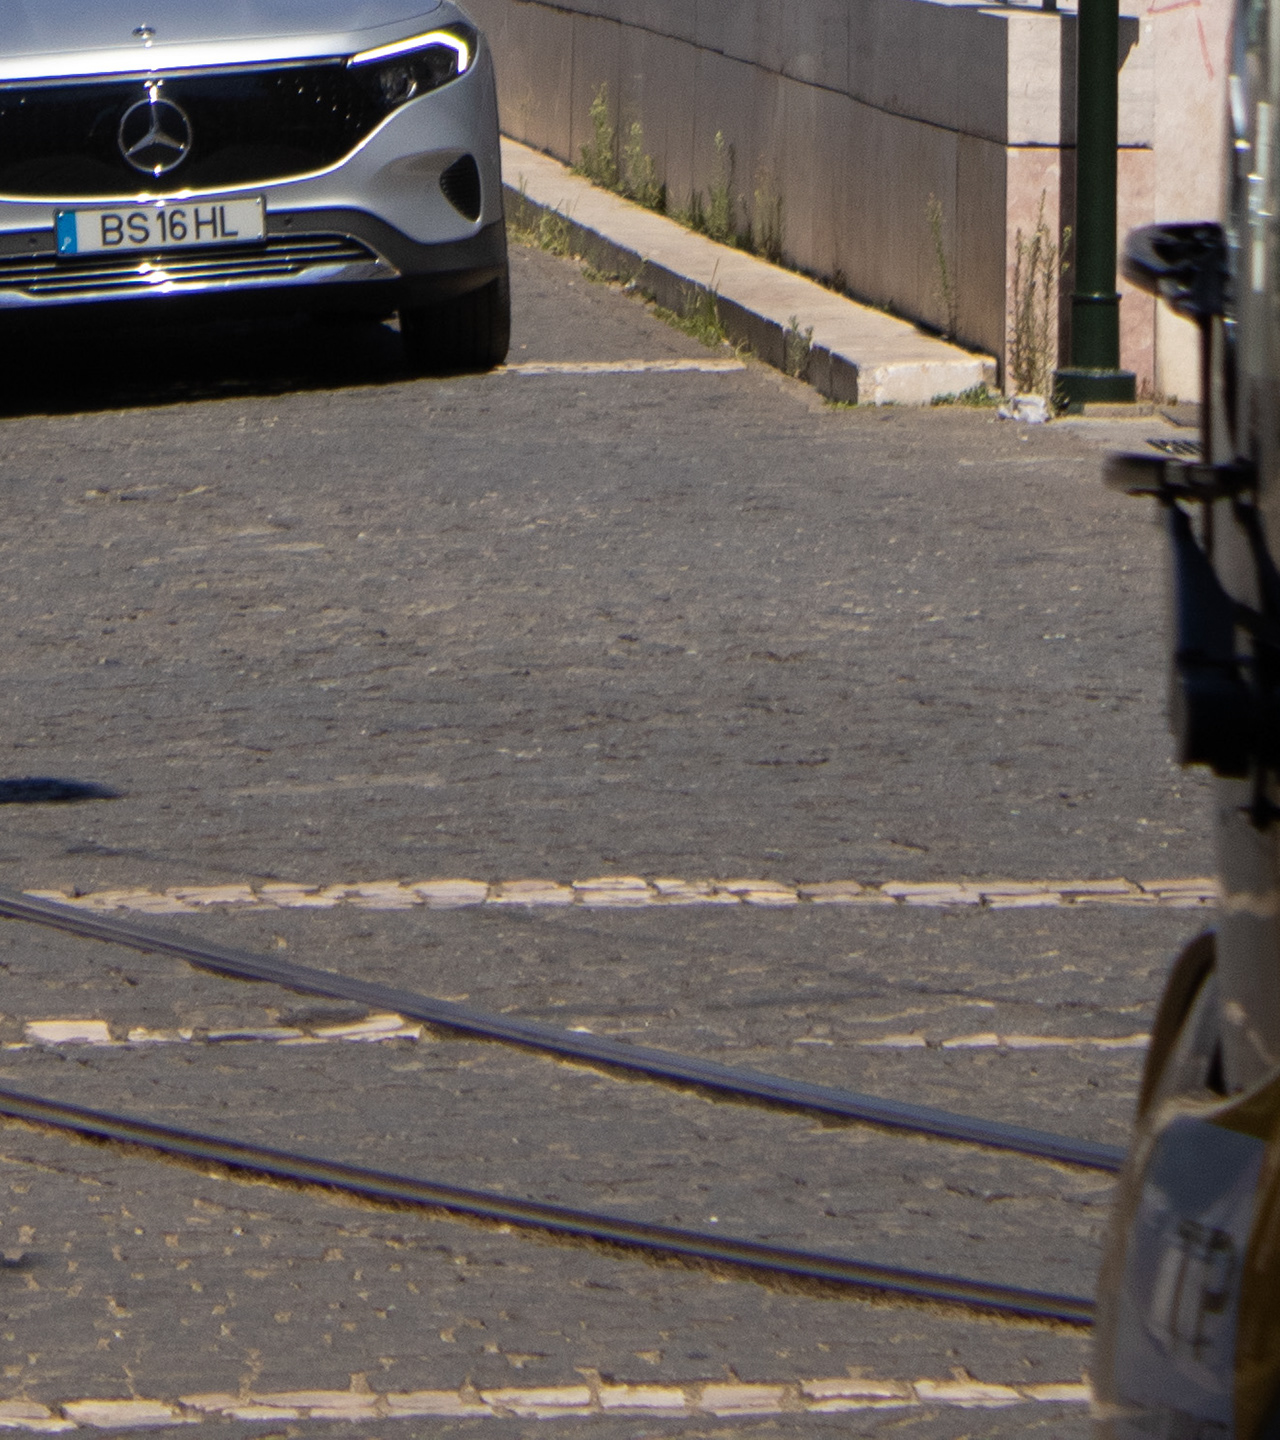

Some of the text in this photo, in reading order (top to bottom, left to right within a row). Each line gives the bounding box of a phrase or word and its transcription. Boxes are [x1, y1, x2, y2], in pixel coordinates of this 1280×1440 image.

[101, 212, 150, 247] BS
[156, 209, 187, 242] 16
[194, 205, 238, 240] HL
